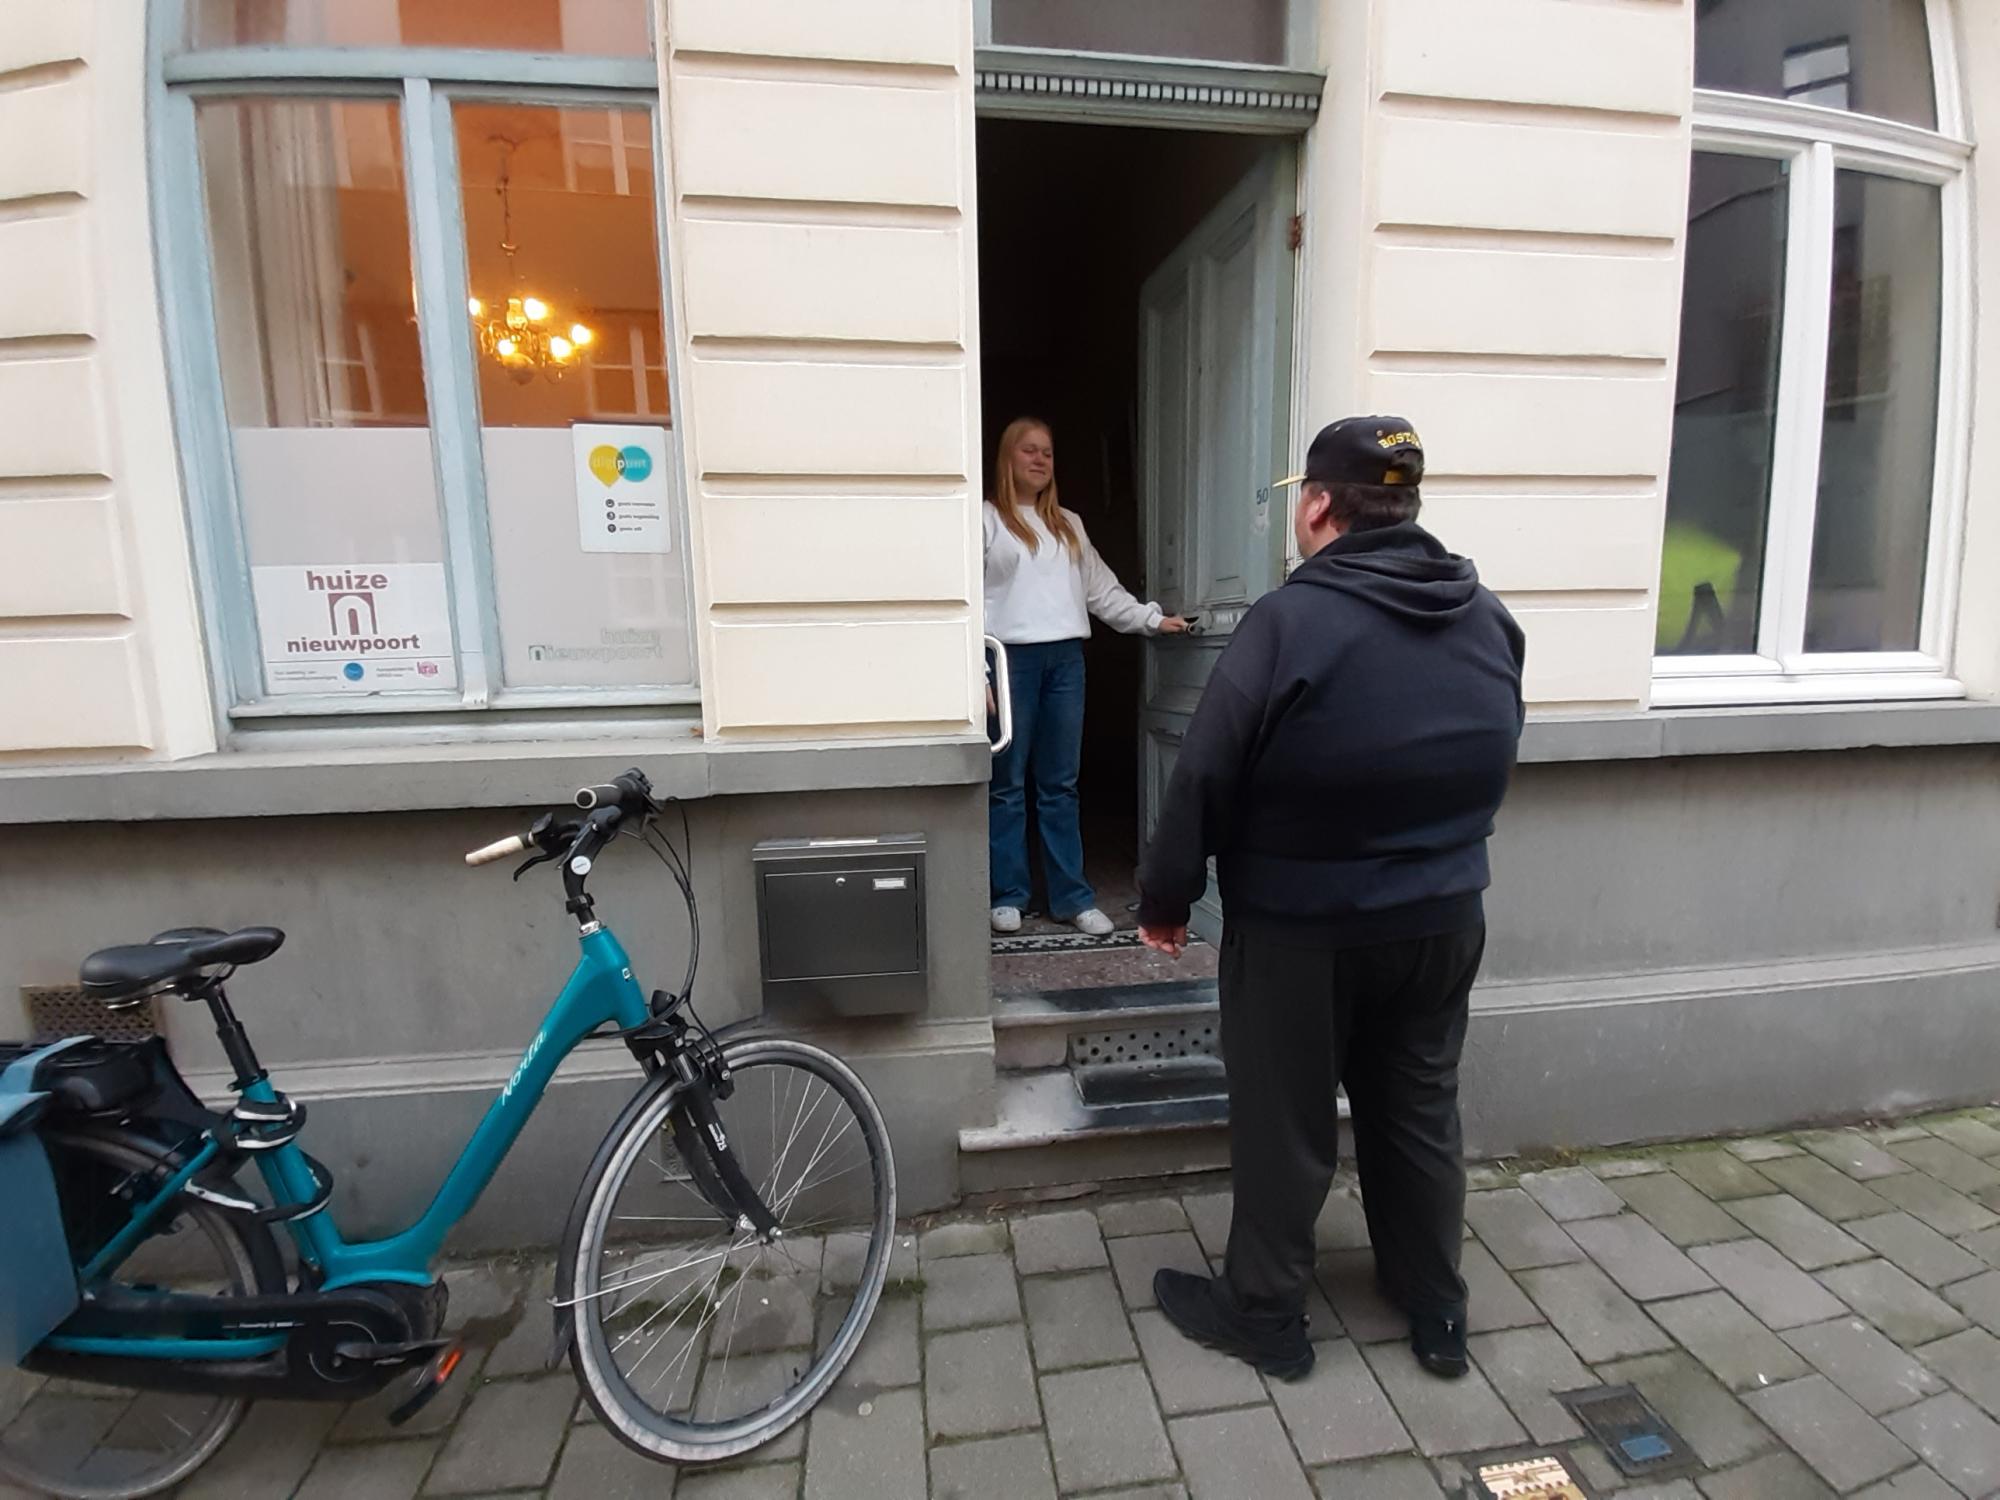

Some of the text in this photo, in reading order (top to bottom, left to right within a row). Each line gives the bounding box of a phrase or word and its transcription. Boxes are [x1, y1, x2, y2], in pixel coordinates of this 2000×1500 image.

[1256, 488, 1269, 505] 50
[306, 570, 388, 591] huize
[287, 635, 421, 654] nieuwpoort
